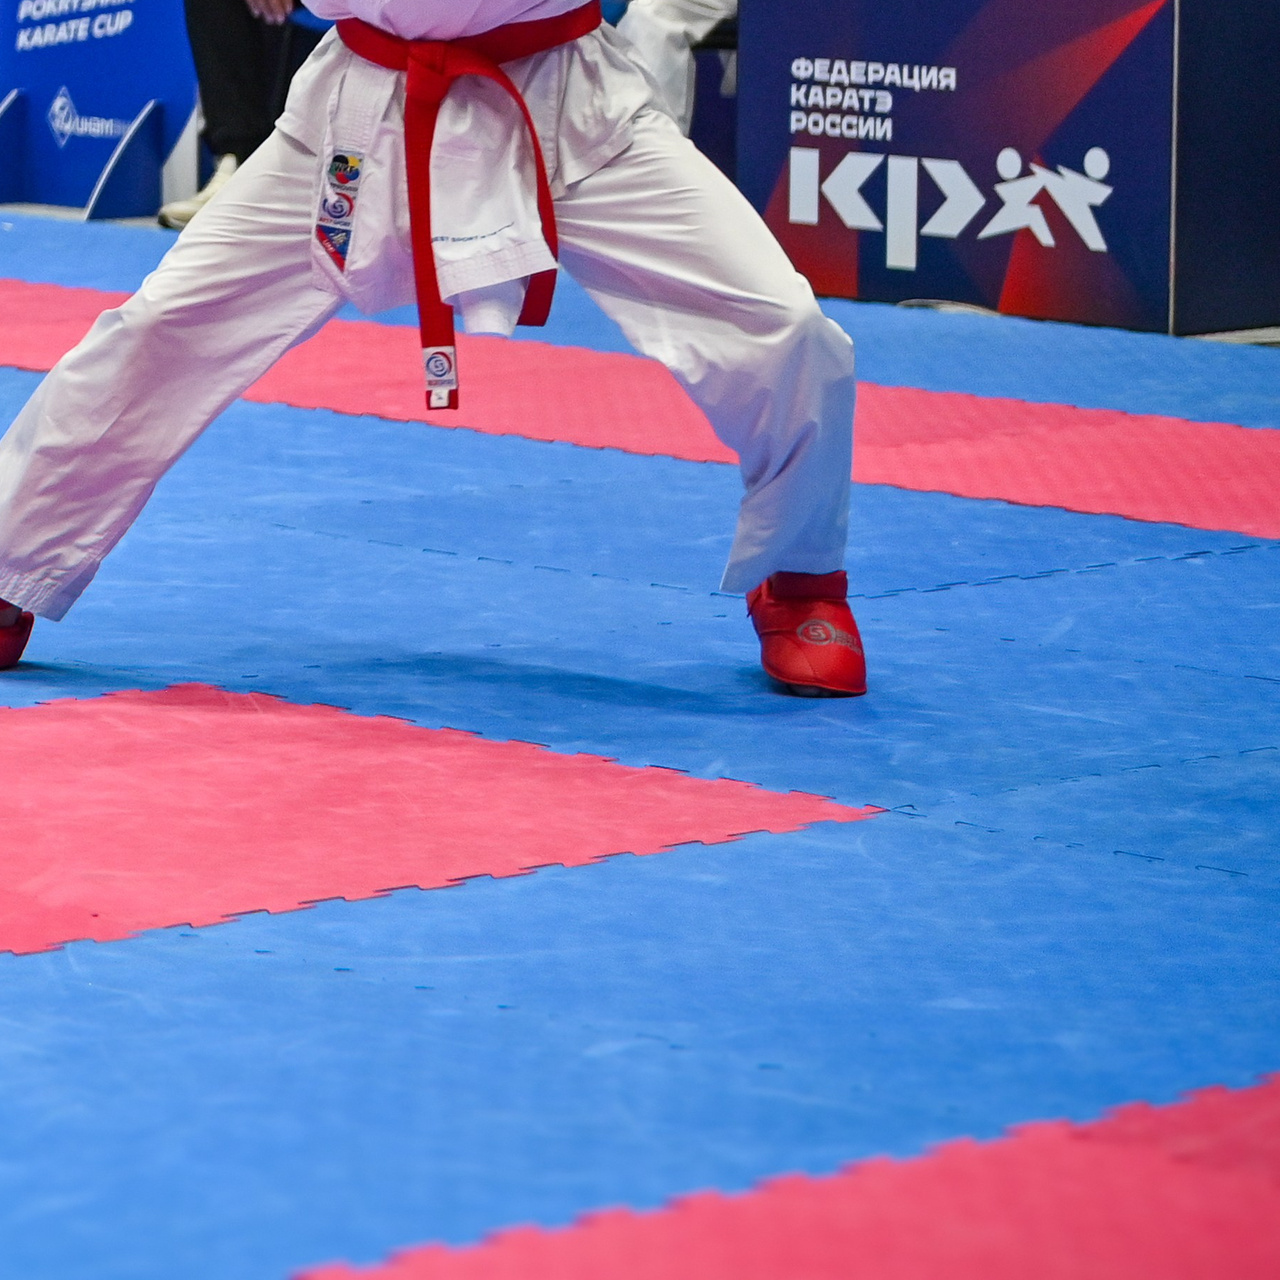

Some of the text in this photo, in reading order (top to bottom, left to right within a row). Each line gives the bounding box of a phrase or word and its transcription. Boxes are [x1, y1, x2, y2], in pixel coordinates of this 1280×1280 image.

[16, 9, 135, 52] KARATE CUP
[790, 57, 957, 92] ФЕДЕРАЦИЯ
[790, 84, 893, 114] КАРАТЭ
[790, 111, 893, 141] РОССИИ
